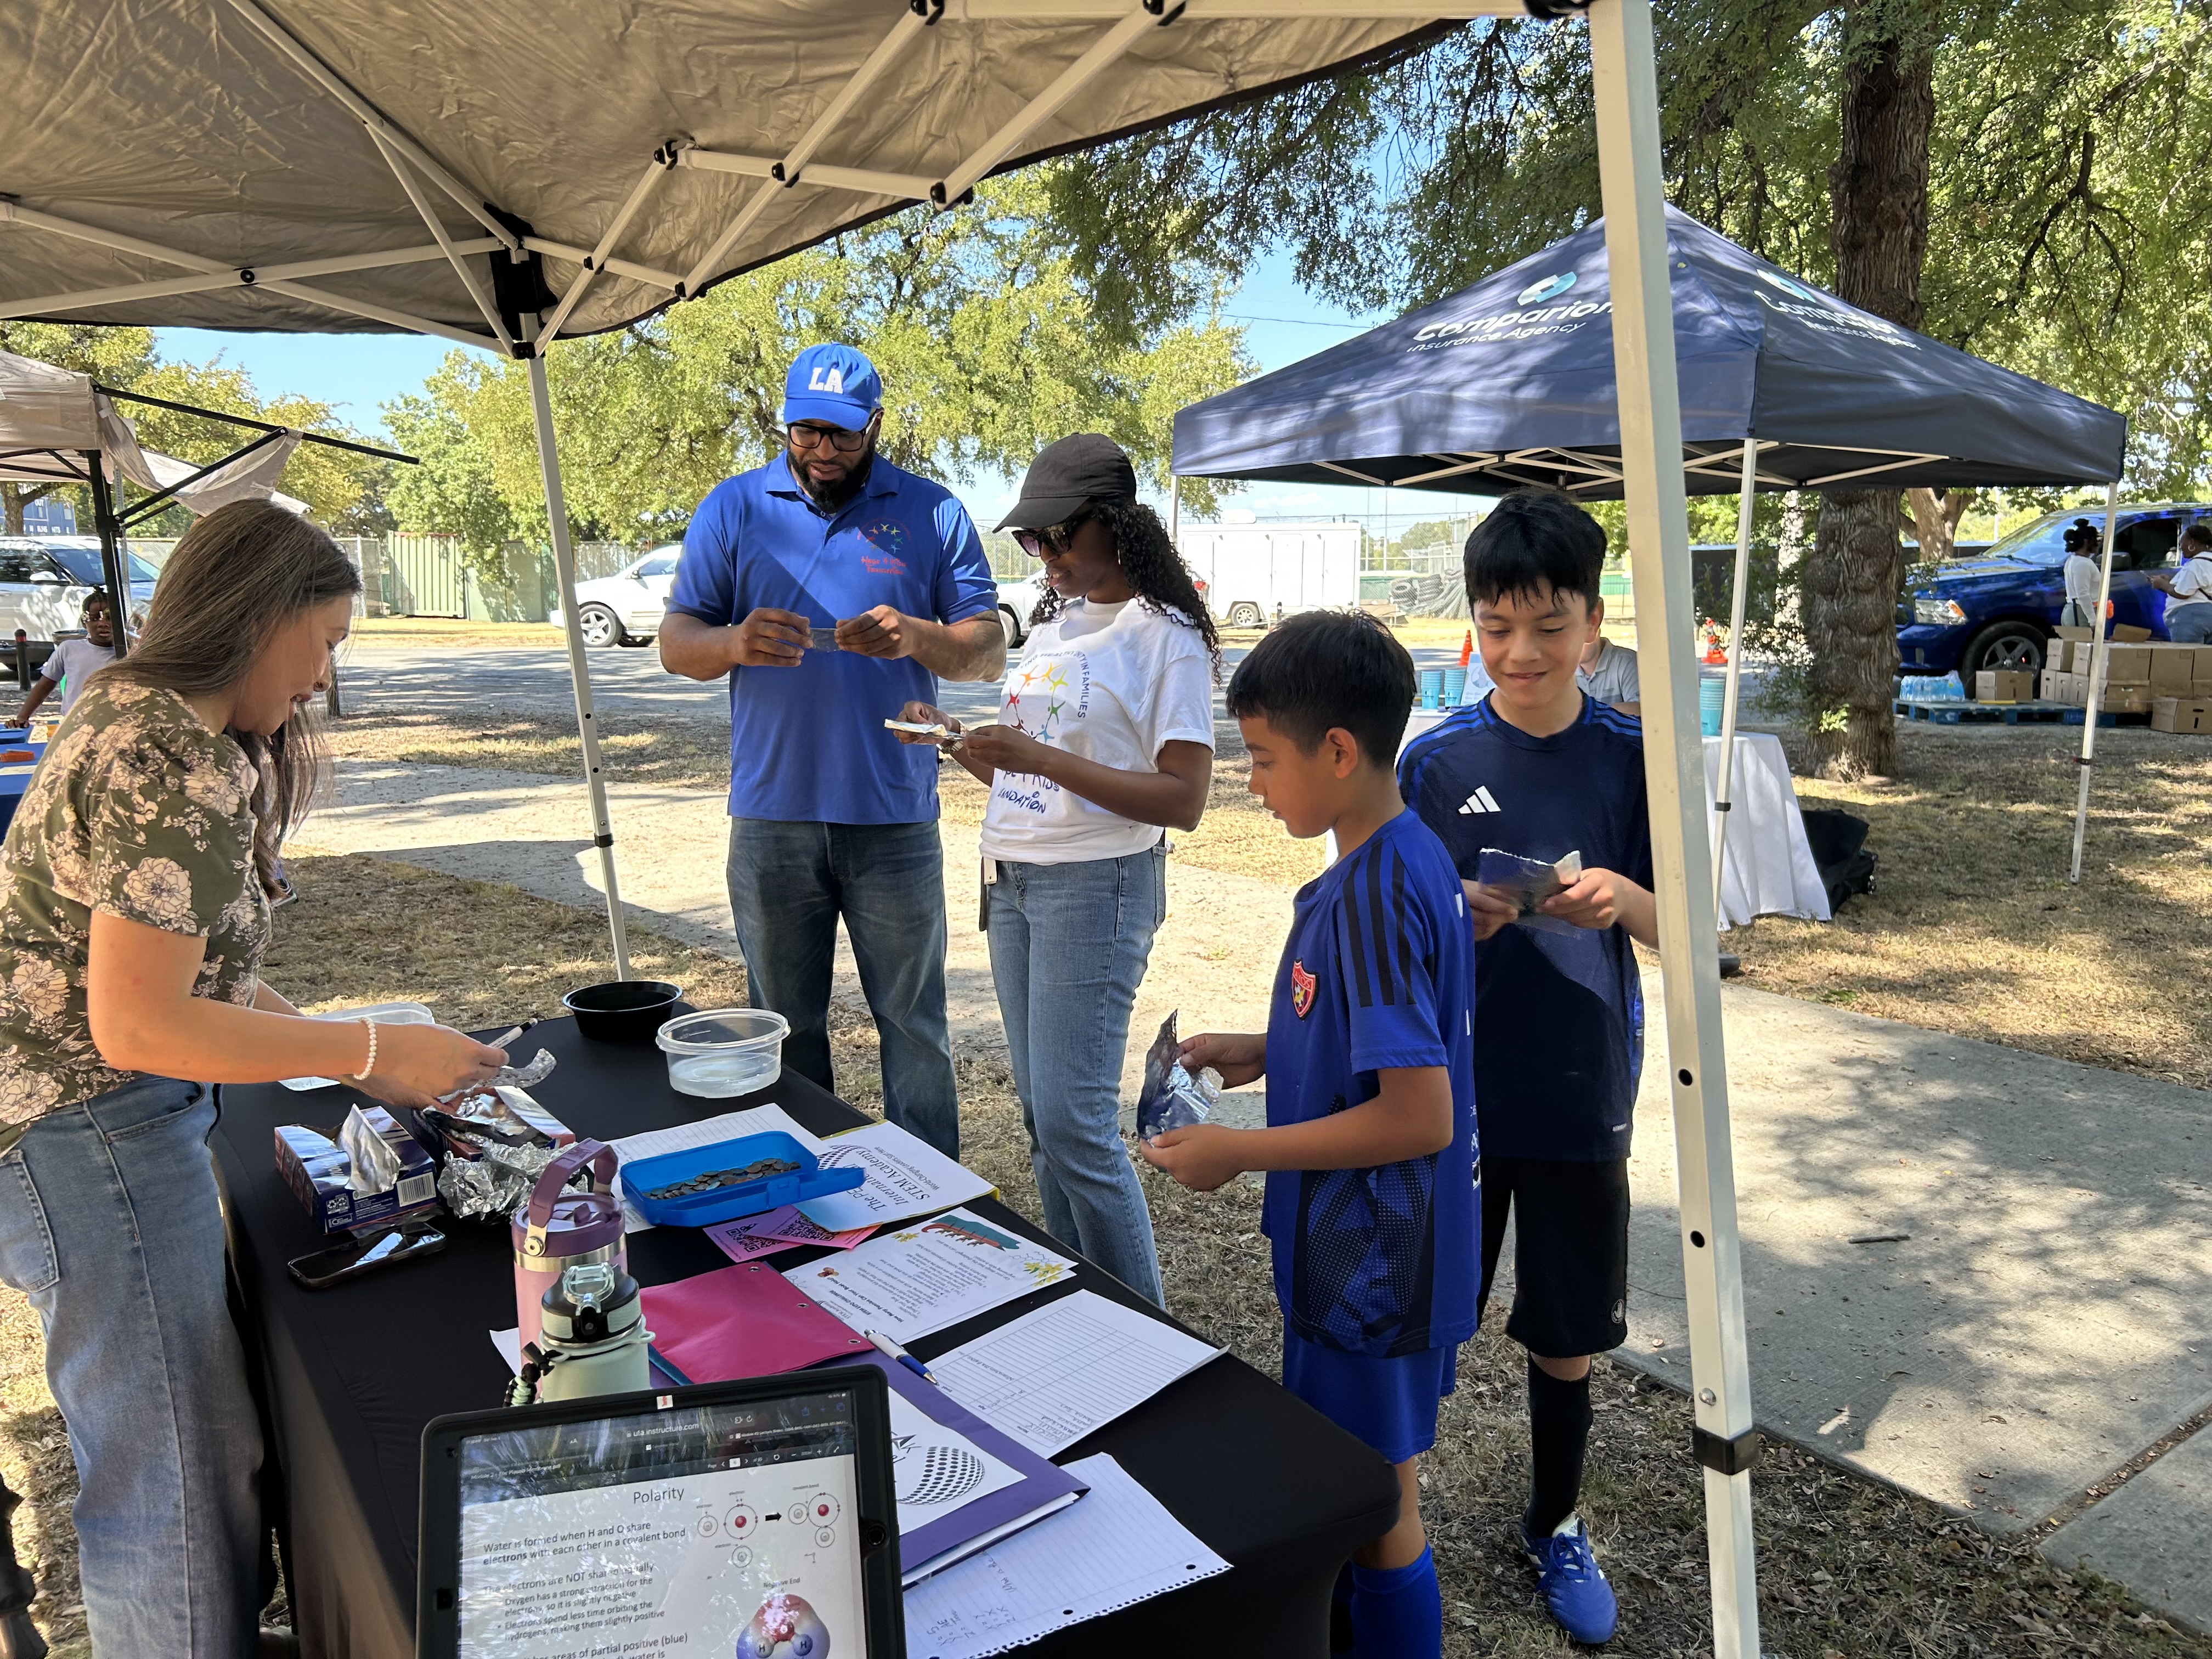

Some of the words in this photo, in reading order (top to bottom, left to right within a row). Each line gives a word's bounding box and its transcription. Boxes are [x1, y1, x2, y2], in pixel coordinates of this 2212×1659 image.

[1413, 301, 1613, 341] Comparion
[1407, 331, 1502, 352] Insurance
[1503, 323, 1586, 338] Agency
[809, 368, 843, 394] LA
[1077, 671, 1090, 718] FAMILIES
[855, 1149, 897, 1178] Academy
[893, 1178, 930, 1200] STEM
[864, 1195, 887, 1211] The
[857, 1307, 872, 1315] STEM
[864, 1299, 884, 1310] Pennies
[879, 1308, 896, 1317] Many
[633, 1421, 699, 1437] uta.instructure.com
[633, 1485, 684, 1506] Polarity
[483, 1540, 511, 1553] Water
[515, 1540, 521, 1548] is
[524, 1533, 557, 1547] formed
[560, 1530, 586, 1542] when
[588, 1528, 595, 1537] H
[597, 1526, 614, 1537] and
[617, 1524, 623, 1534] O
[626, 1520, 651, 1532] share
[483, 1550, 527, 1565] electrons
[529, 1547, 548, 1559] with
[552, 1543, 574, 1555] each
[577, 1539, 602, 1551] other
[604, 1538, 612, 1548] in
[614, 1538, 619, 1547] a
[623, 1531, 660, 1546] covalent
[663, 1527, 685, 1539] bond
[503, 1577, 546, 1592] electrons
[548, 1576, 563, 1585] are
[566, 1571, 584, 1583] NOT
[505, 1594, 534, 1607] Oxygen
[537, 1591, 550, 1601] has
[560, 1587, 584, 1600] strong
[626, 1578, 638, 1588] for
[640, 1576, 652, 1585] the
[546, 1602, 555, 1611] so
[557, 1600, 562, 1609] it
[565, 1599, 571, 1607] is
[573, 1594, 600, 1609] slightly
[505, 1617, 542, 1630] Electrons
[544, 1612, 568, 1625] spend
[570, 1609, 585, 1620] less
[586, 1607, 604, 1617] time
[607, 1602, 637, 1615] orbiting
[640, 1600, 652, 1609] the
[550, 1621, 579, 1635] making
[582, 1617, 602, 1629] them
[604, 1612, 633, 1627] slightly
[634, 1609, 664, 1623] positive
[552, 1650, 577, 1659] areas
[579, 1647, 589, 1658] of
[591, 1641, 620, 1658] partial
[623, 1636, 658, 1652] positive
[661, 1632, 688, 1647] (blue)
[658, 1649, 665, 1658] is
[759, 1644, 765, 1652] H
[800, 1638, 807, 1646] H
